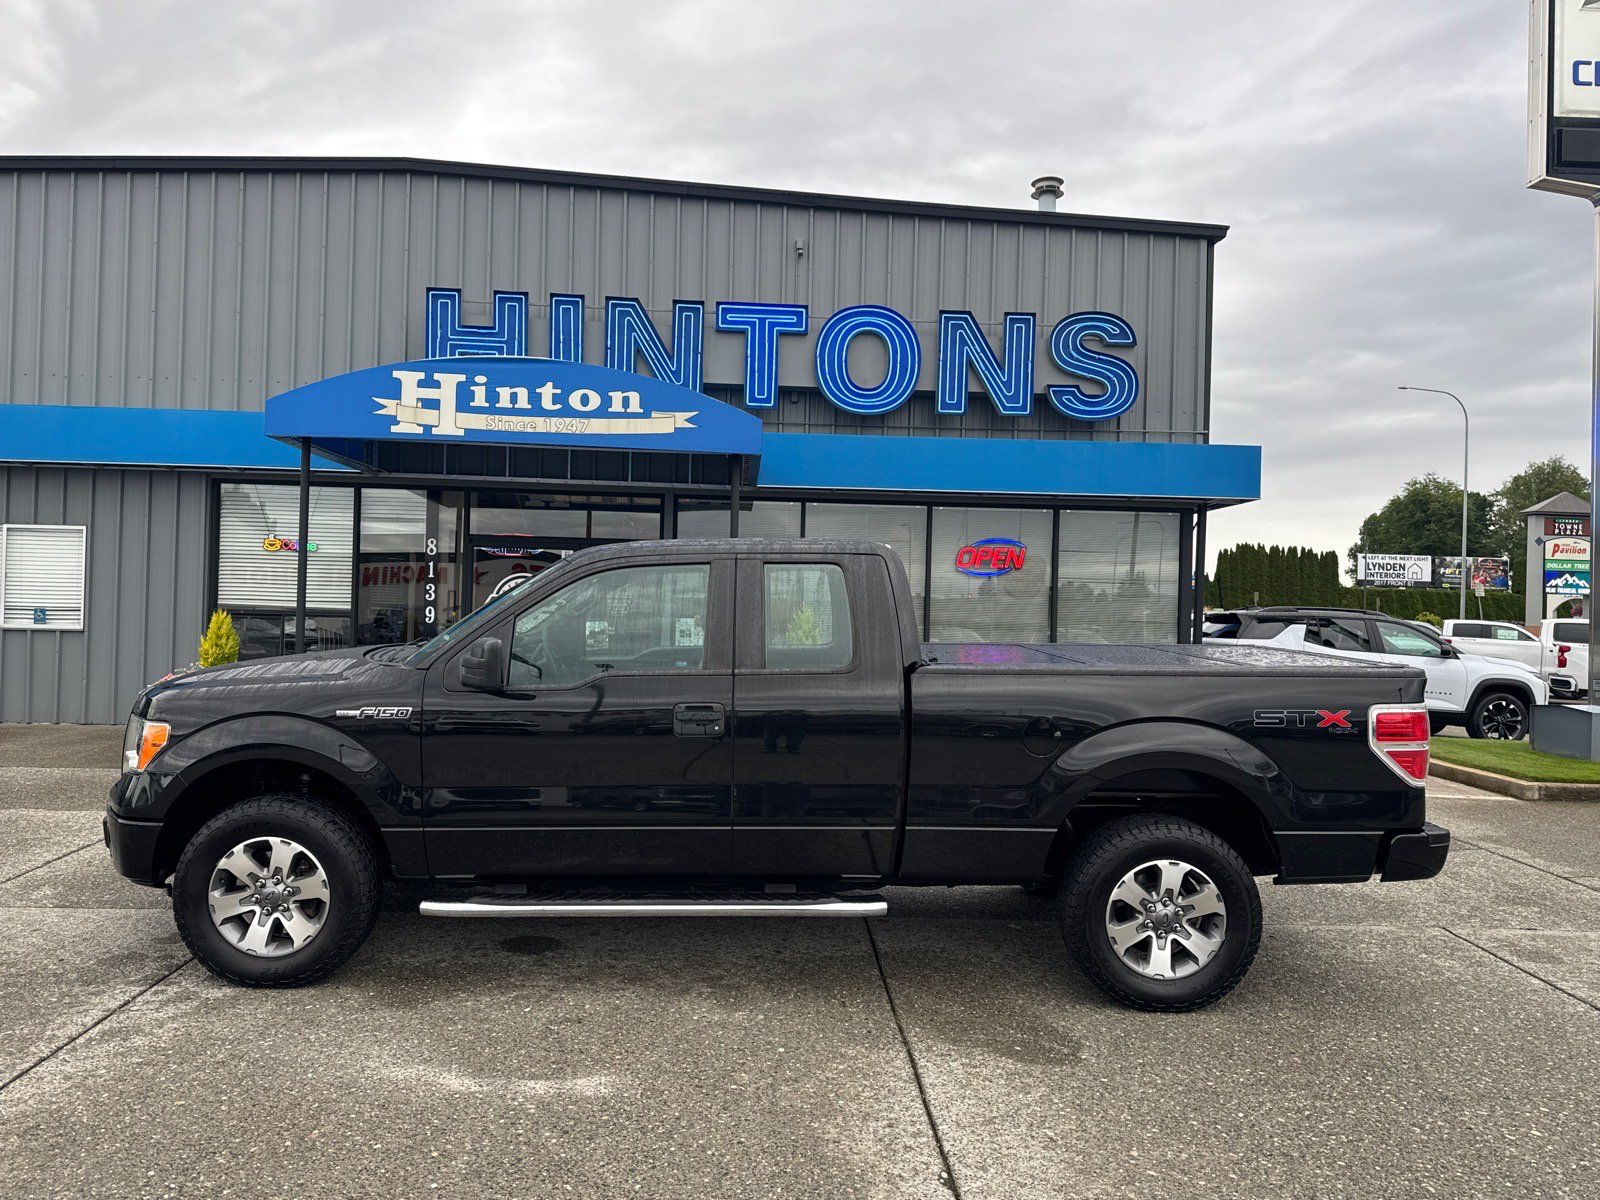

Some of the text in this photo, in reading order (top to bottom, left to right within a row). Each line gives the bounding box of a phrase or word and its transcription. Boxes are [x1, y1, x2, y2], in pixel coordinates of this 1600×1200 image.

[1572, 59, 1600, 87] C
[425, 286, 1139, 421] HINTONS
[390, 370, 644, 437] Hinton
[485, 415, 591, 433] Since 1947
[956, 545, 1027, 570] OPEN
[1551, 543, 1587, 557] Pavilion
[1366, 572, 1406, 580] INTERIORS
[1367, 562, 1406, 572] LYNDEN
[425, 538, 437, 623] 8139
[357, 706, 413, 719] F-150
[1253, 709, 1352, 728] STX
